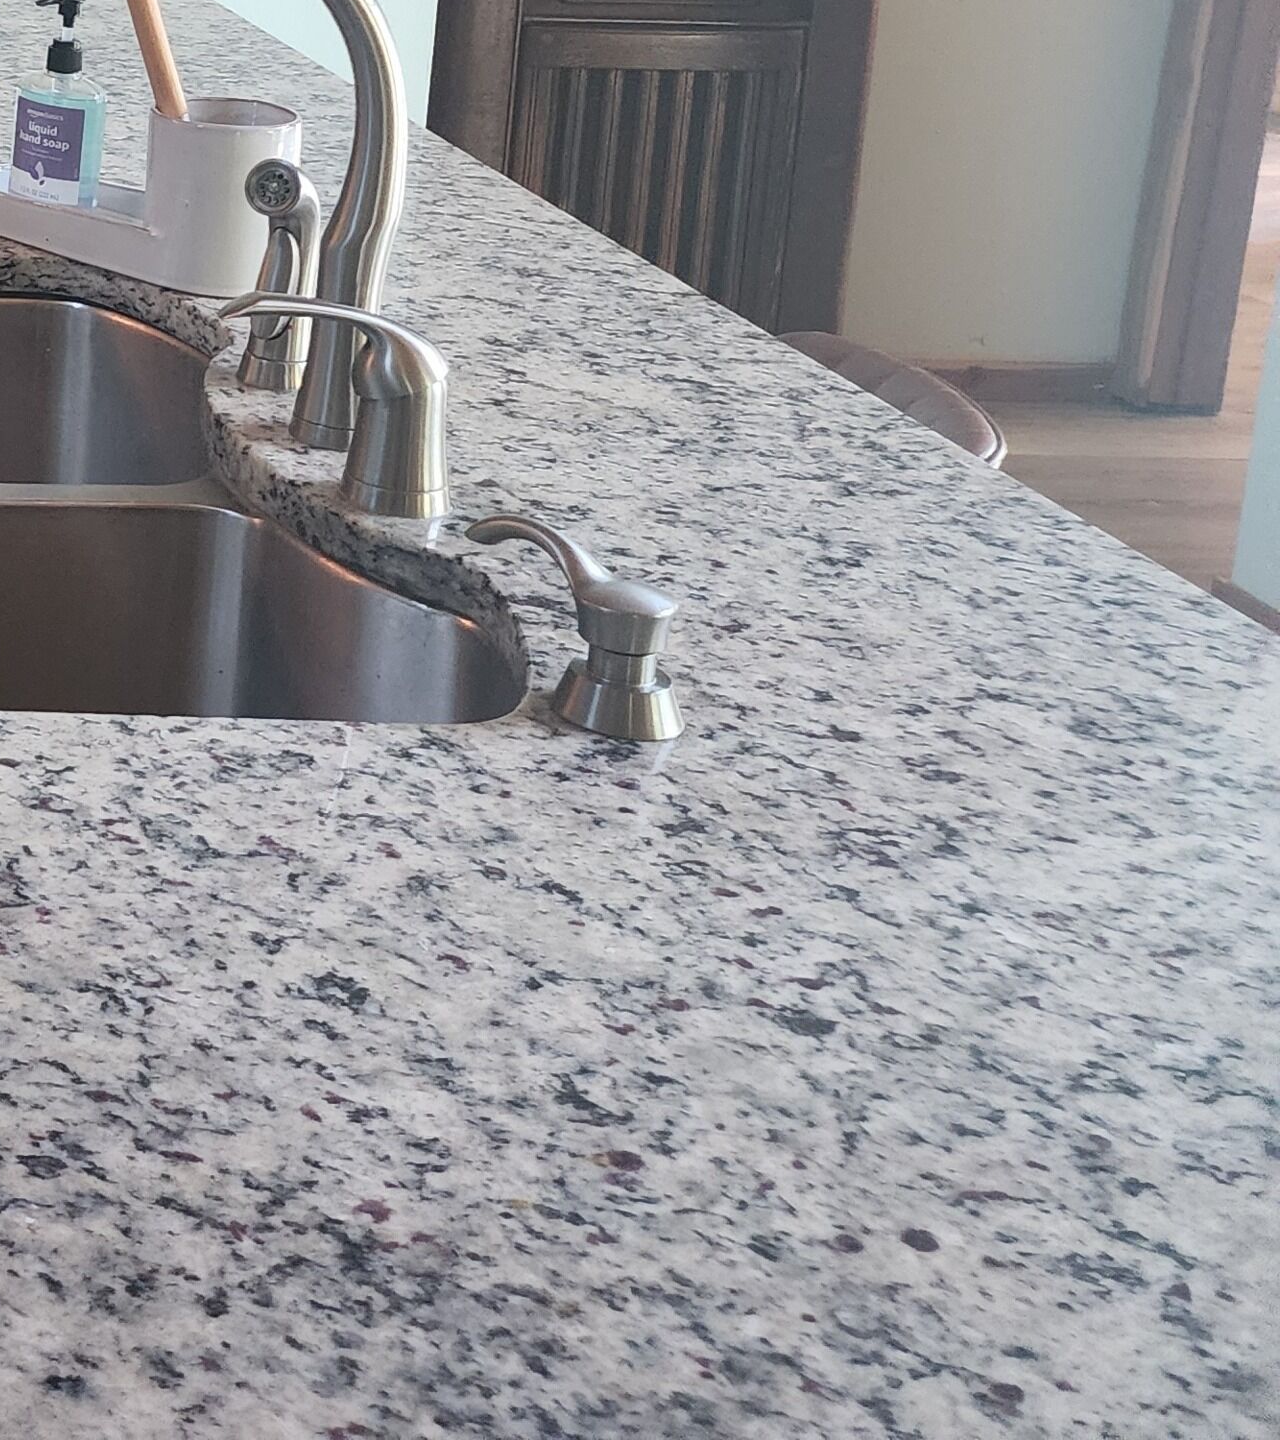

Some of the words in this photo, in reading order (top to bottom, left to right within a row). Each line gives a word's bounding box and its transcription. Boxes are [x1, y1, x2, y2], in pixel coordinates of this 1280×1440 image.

[28, 120, 58, 136] liquid
[19, 129, 42, 145] hand
[42, 138, 70, 152] soap
